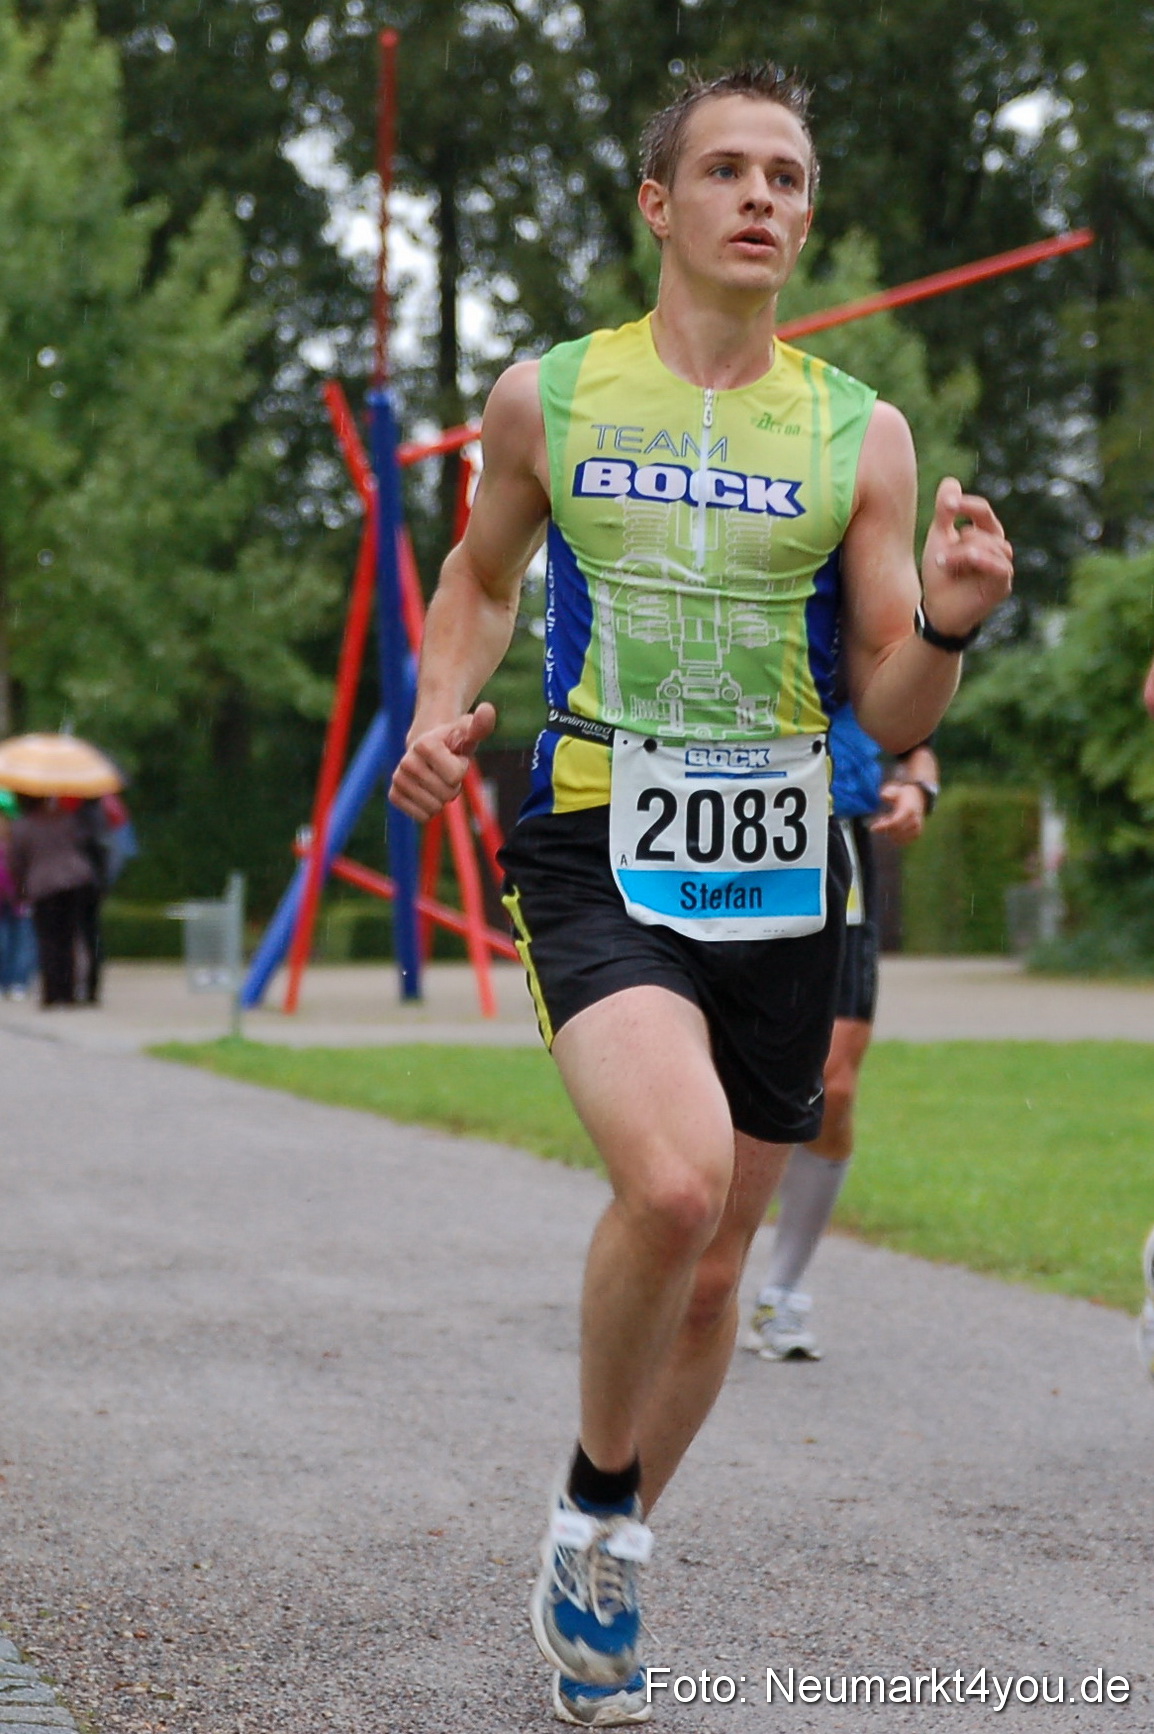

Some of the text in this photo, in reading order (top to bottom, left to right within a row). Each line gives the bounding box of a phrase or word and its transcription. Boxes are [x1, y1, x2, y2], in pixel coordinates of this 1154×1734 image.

[591, 424, 728, 462] TEAM
[572, 457, 806, 518] BOCK
[685, 748, 770, 768] BOCK
[635, 787, 808, 864] 2083
[620, 854, 628, 866] A
[680, 881, 762, 910] Stefan
